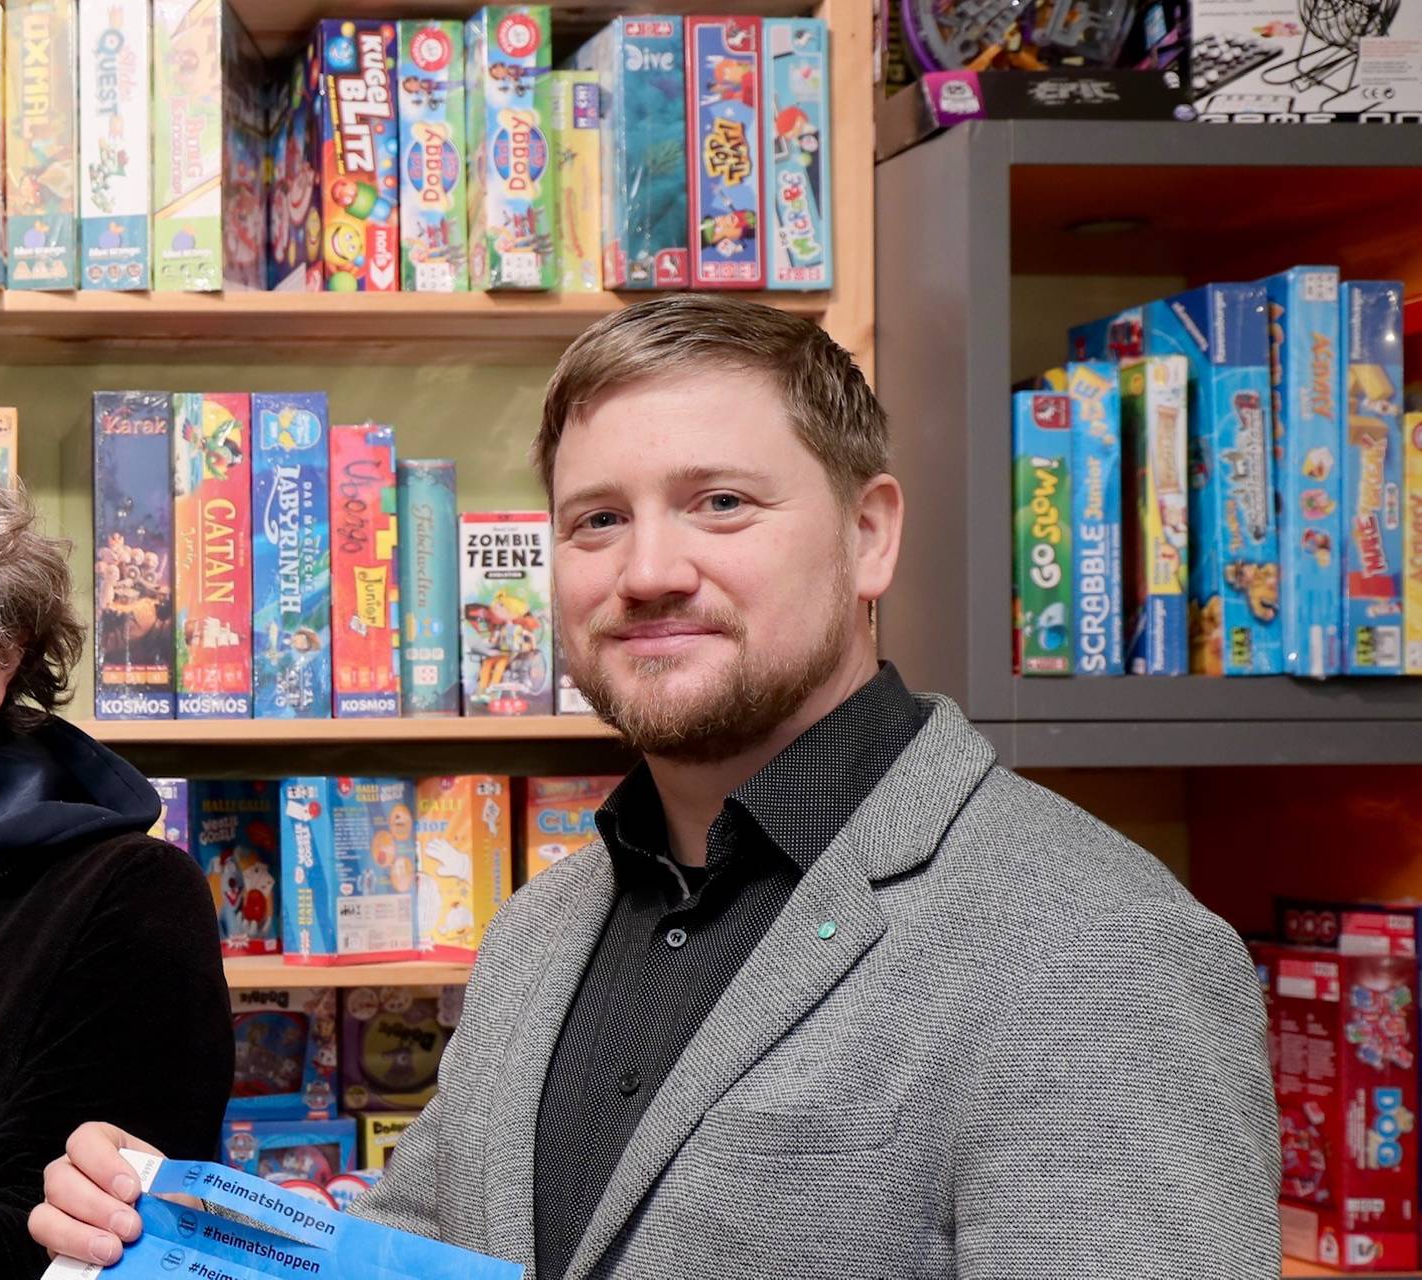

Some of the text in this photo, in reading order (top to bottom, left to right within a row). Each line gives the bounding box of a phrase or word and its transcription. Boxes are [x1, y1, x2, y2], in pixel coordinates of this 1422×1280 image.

[23, 14, 50, 139] UXMAL
[96, 29, 126, 116] QUEST
[625, 45, 675, 71] Dive
[422, 129, 443, 203] Doggy
[509, 115, 530, 191] Doggy
[376, 230, 393, 268] noris
[1215, 290, 1227, 363] Ravensburger
[103, 415, 167, 435] Karak
[304, 481, 313, 508] DAS
[1032, 456, 1063, 544] SLOW!
[203, 498, 237, 604] CATAN
[270, 463, 302, 615] LABYRINTH
[467, 533, 541, 548] ZOMBIE
[467, 549, 544, 568] TEENZ
[1030, 543, 1062, 589] GO
[1082, 455, 1111, 672] SCRABBLE Junior
[357, 570, 377, 625] Junior
[101, 699, 170, 715] KOSMOS
[179, 699, 248, 714] KOSMOS
[341, 700, 396, 712] KOSMOS
[1374, 1087, 1403, 1168] DOG
[202, 1172, 337, 1237] #heimatshoppen
[202, 1225, 321, 1274] #heimatshoppen
